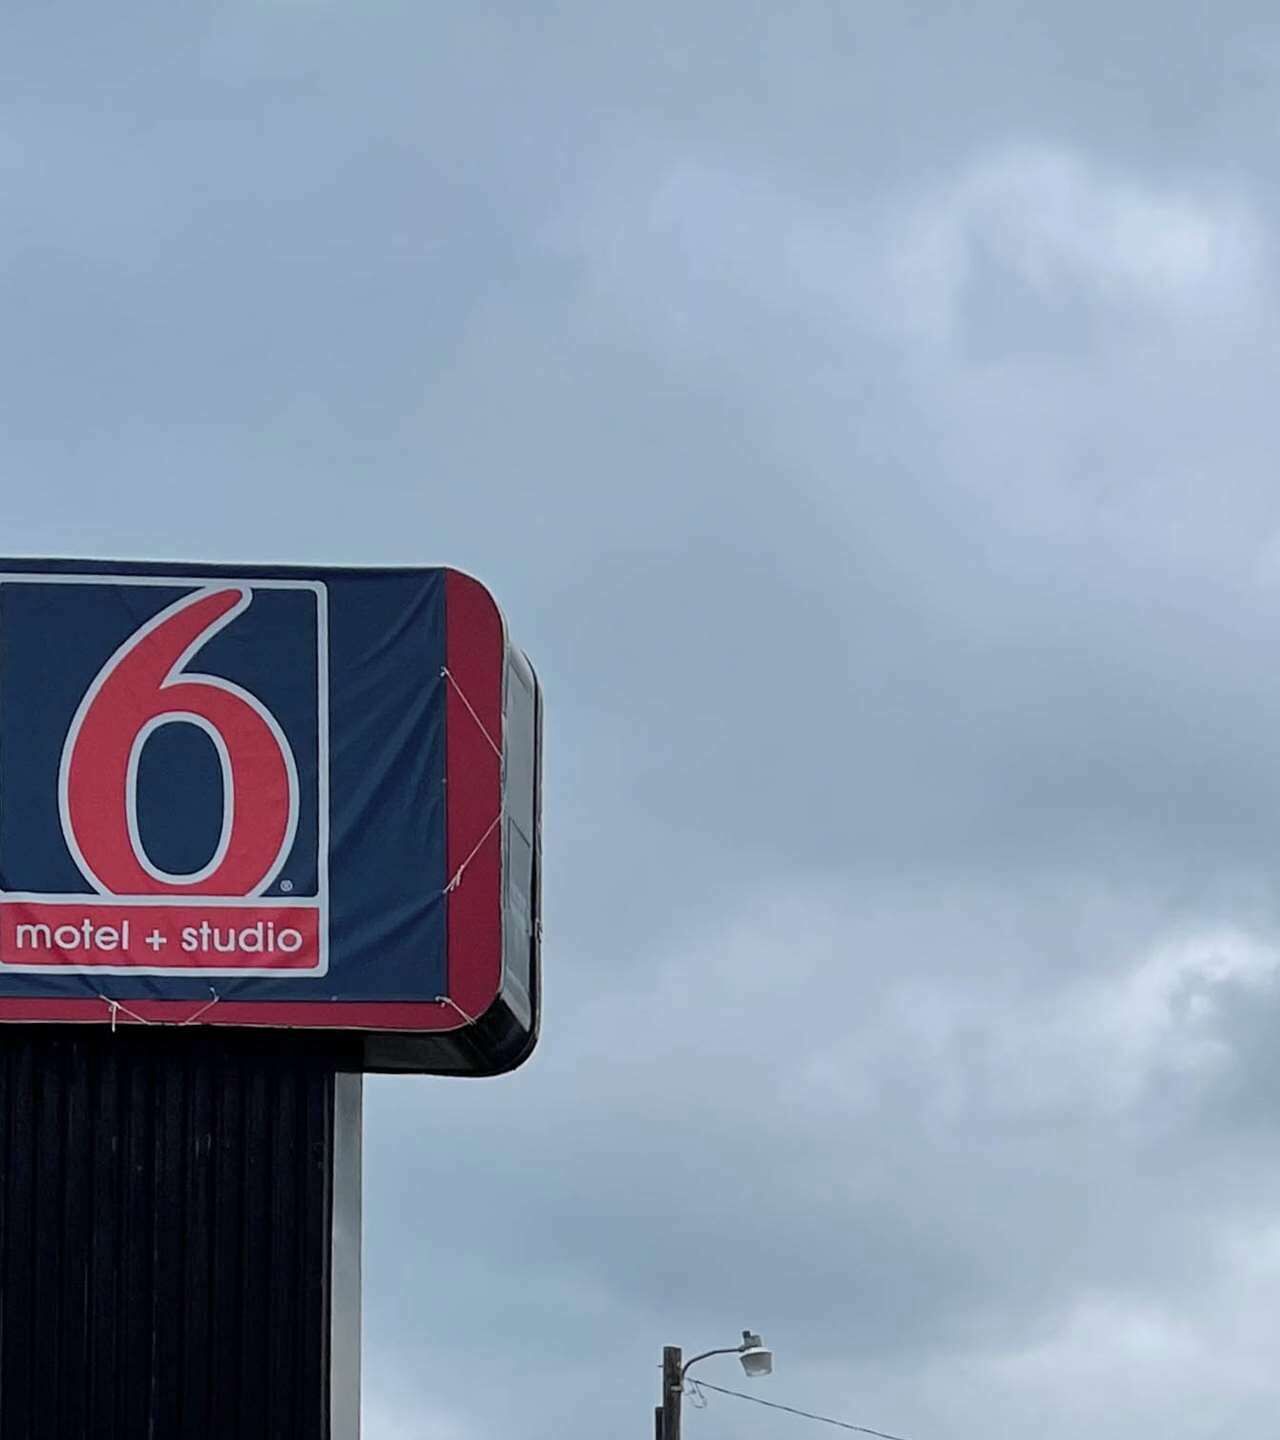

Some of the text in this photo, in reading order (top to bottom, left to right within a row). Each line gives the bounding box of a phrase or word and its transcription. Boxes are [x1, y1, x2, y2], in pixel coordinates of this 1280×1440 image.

[59, 585, 299, 898] 6
[16, 919, 129, 951] motel
[181, 921, 303, 953] studio
